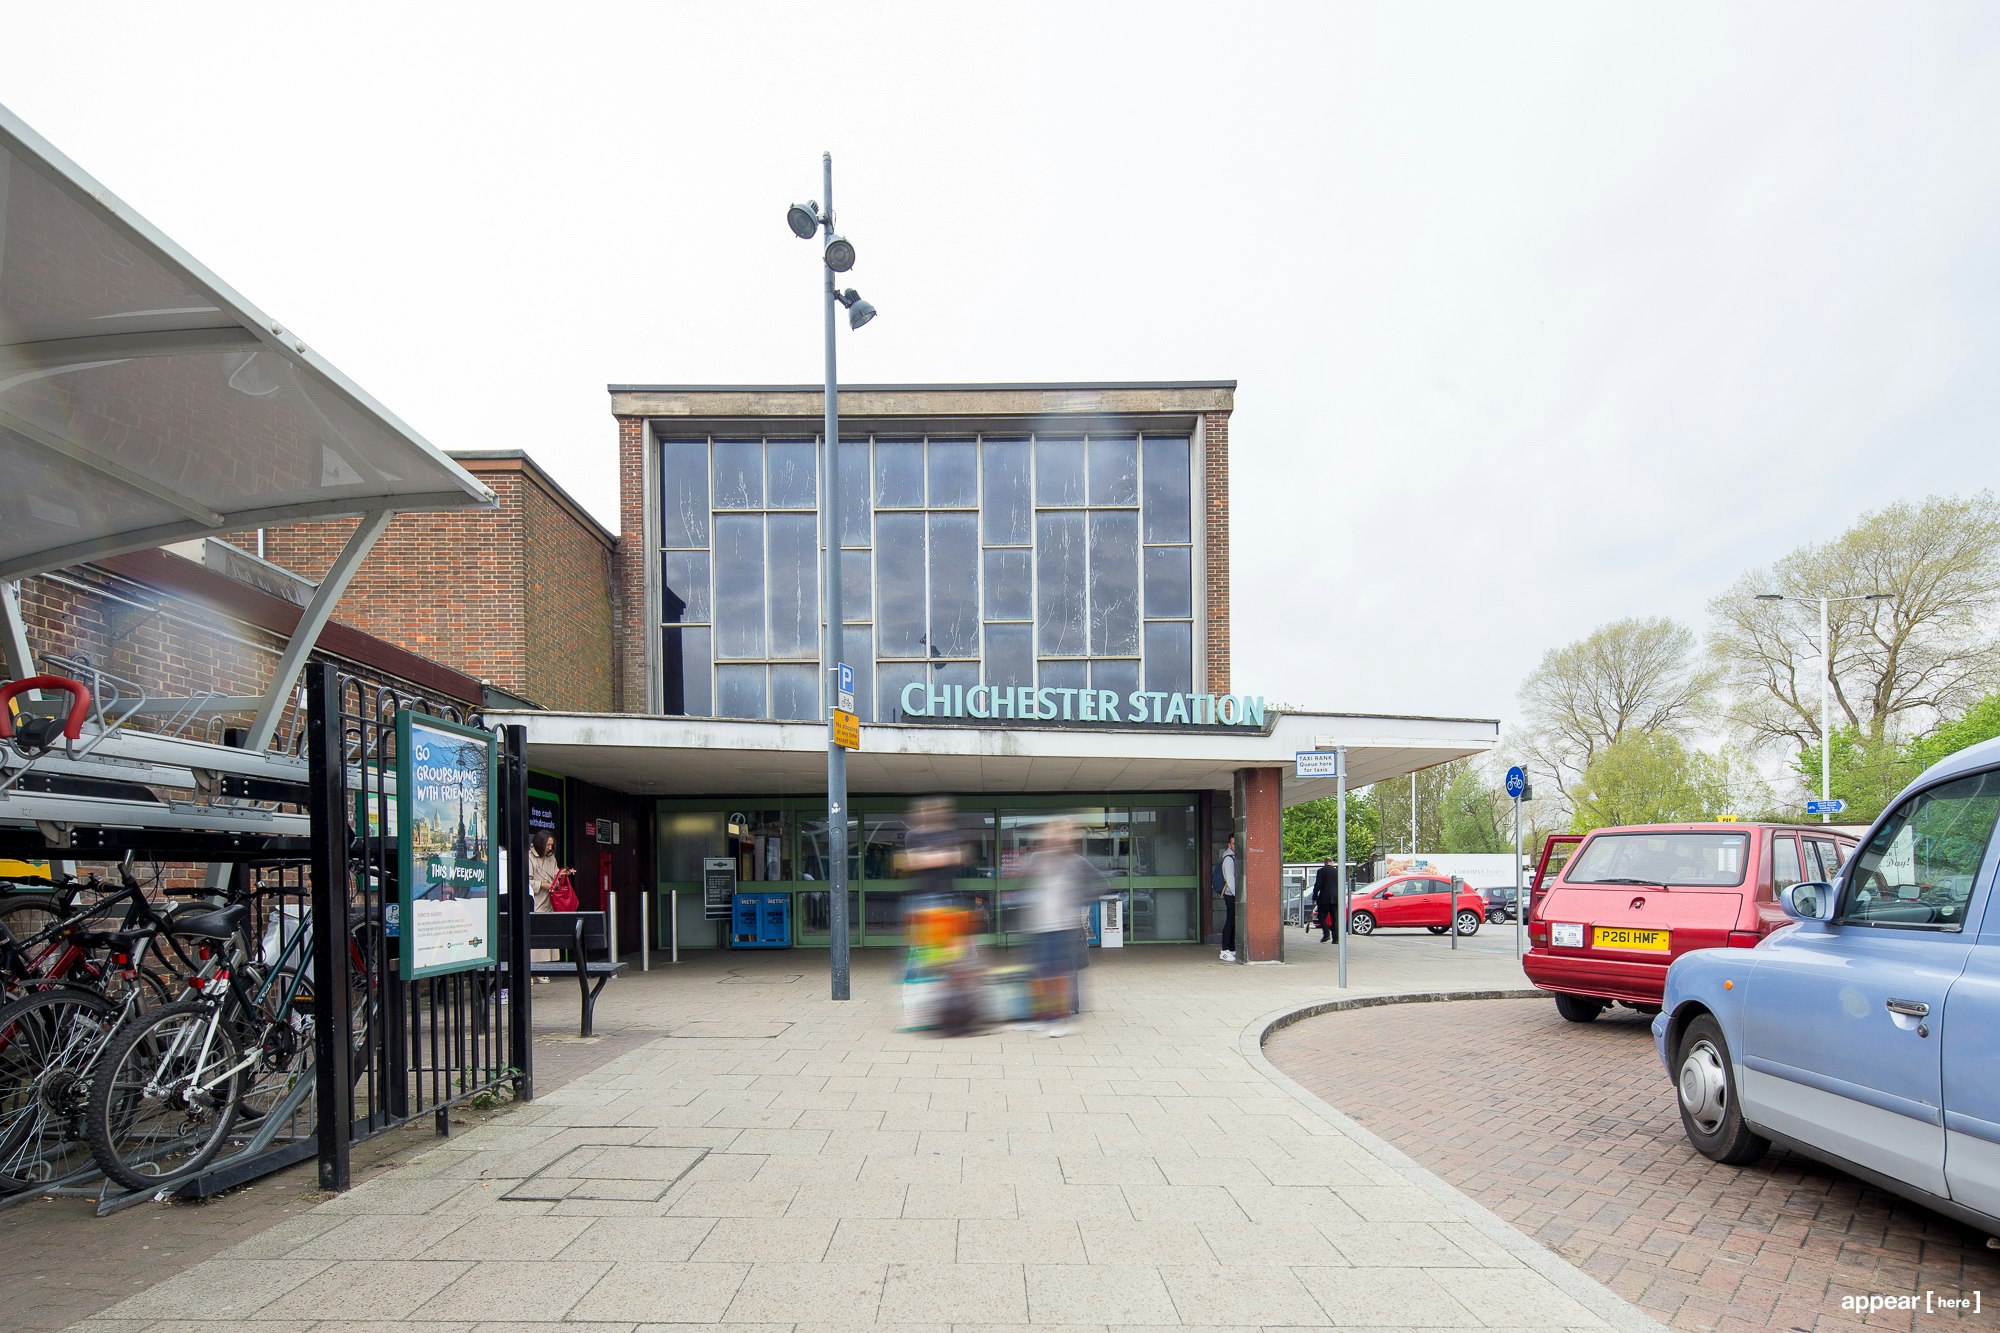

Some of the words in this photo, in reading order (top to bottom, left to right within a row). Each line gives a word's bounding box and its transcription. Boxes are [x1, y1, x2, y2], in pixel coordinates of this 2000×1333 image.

[842, 667, 852, 689] P
[900, 682, 1121, 722] CHICHESTER
[1127, 690, 1264, 726] STATION
[415, 744, 430, 761] GO
[416, 764, 477, 785] GROUPSAVING
[417, 784, 439, 802] WITH
[531, 806, 541, 817] free
[542, 809, 553, 819] cash
[529, 817, 556, 829] withdrawals
[431, 863, 447, 879] THIS
[449, 865, 485, 882] WEEKEND!
[1602, 930, 1630, 943] P261
[1633, 932, 1659, 944] HMF
